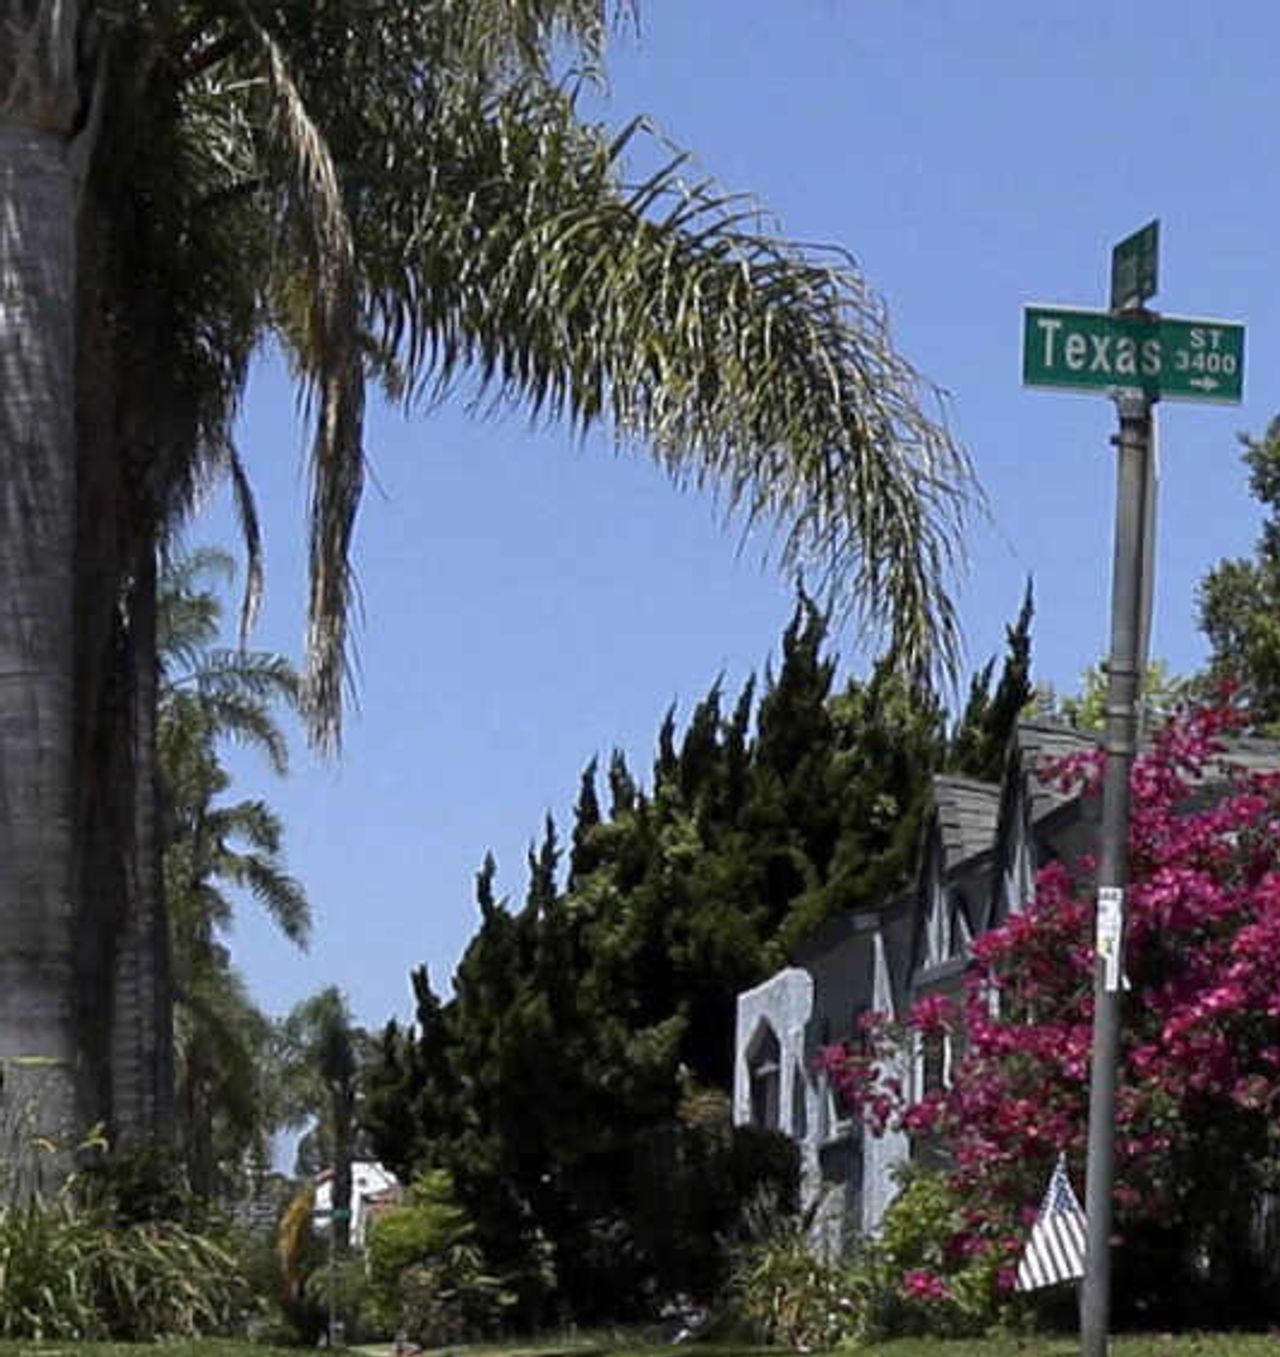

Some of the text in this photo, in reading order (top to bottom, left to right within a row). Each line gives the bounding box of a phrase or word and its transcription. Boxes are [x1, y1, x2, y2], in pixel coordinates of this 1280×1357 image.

[1037, 319, 1162, 376] Texas
[1189, 328, 1224, 350] ST
[1174, 351, 1237, 374] 3400
